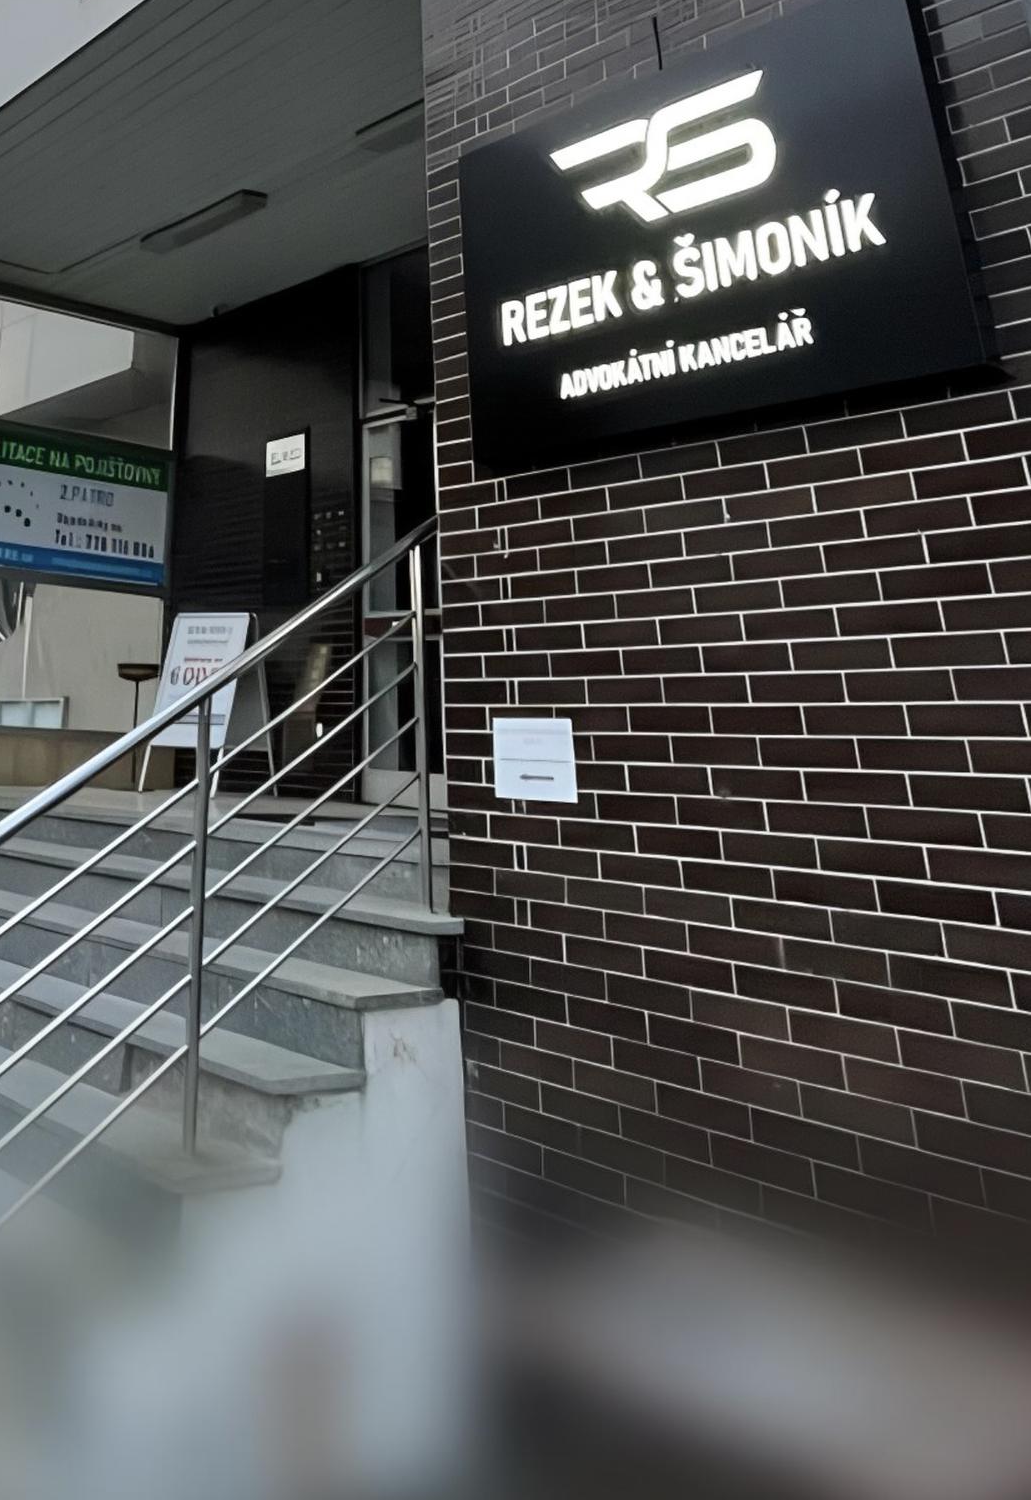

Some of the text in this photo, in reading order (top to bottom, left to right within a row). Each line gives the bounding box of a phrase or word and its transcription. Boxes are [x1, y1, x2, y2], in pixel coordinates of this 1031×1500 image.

[501, 188, 887, 346] REZEK & ŠIMONÍK
[560, 308, 815, 400] ADVOKÁTNÍ KANCELÁŘ
[50, 450, 70, 469] NA
